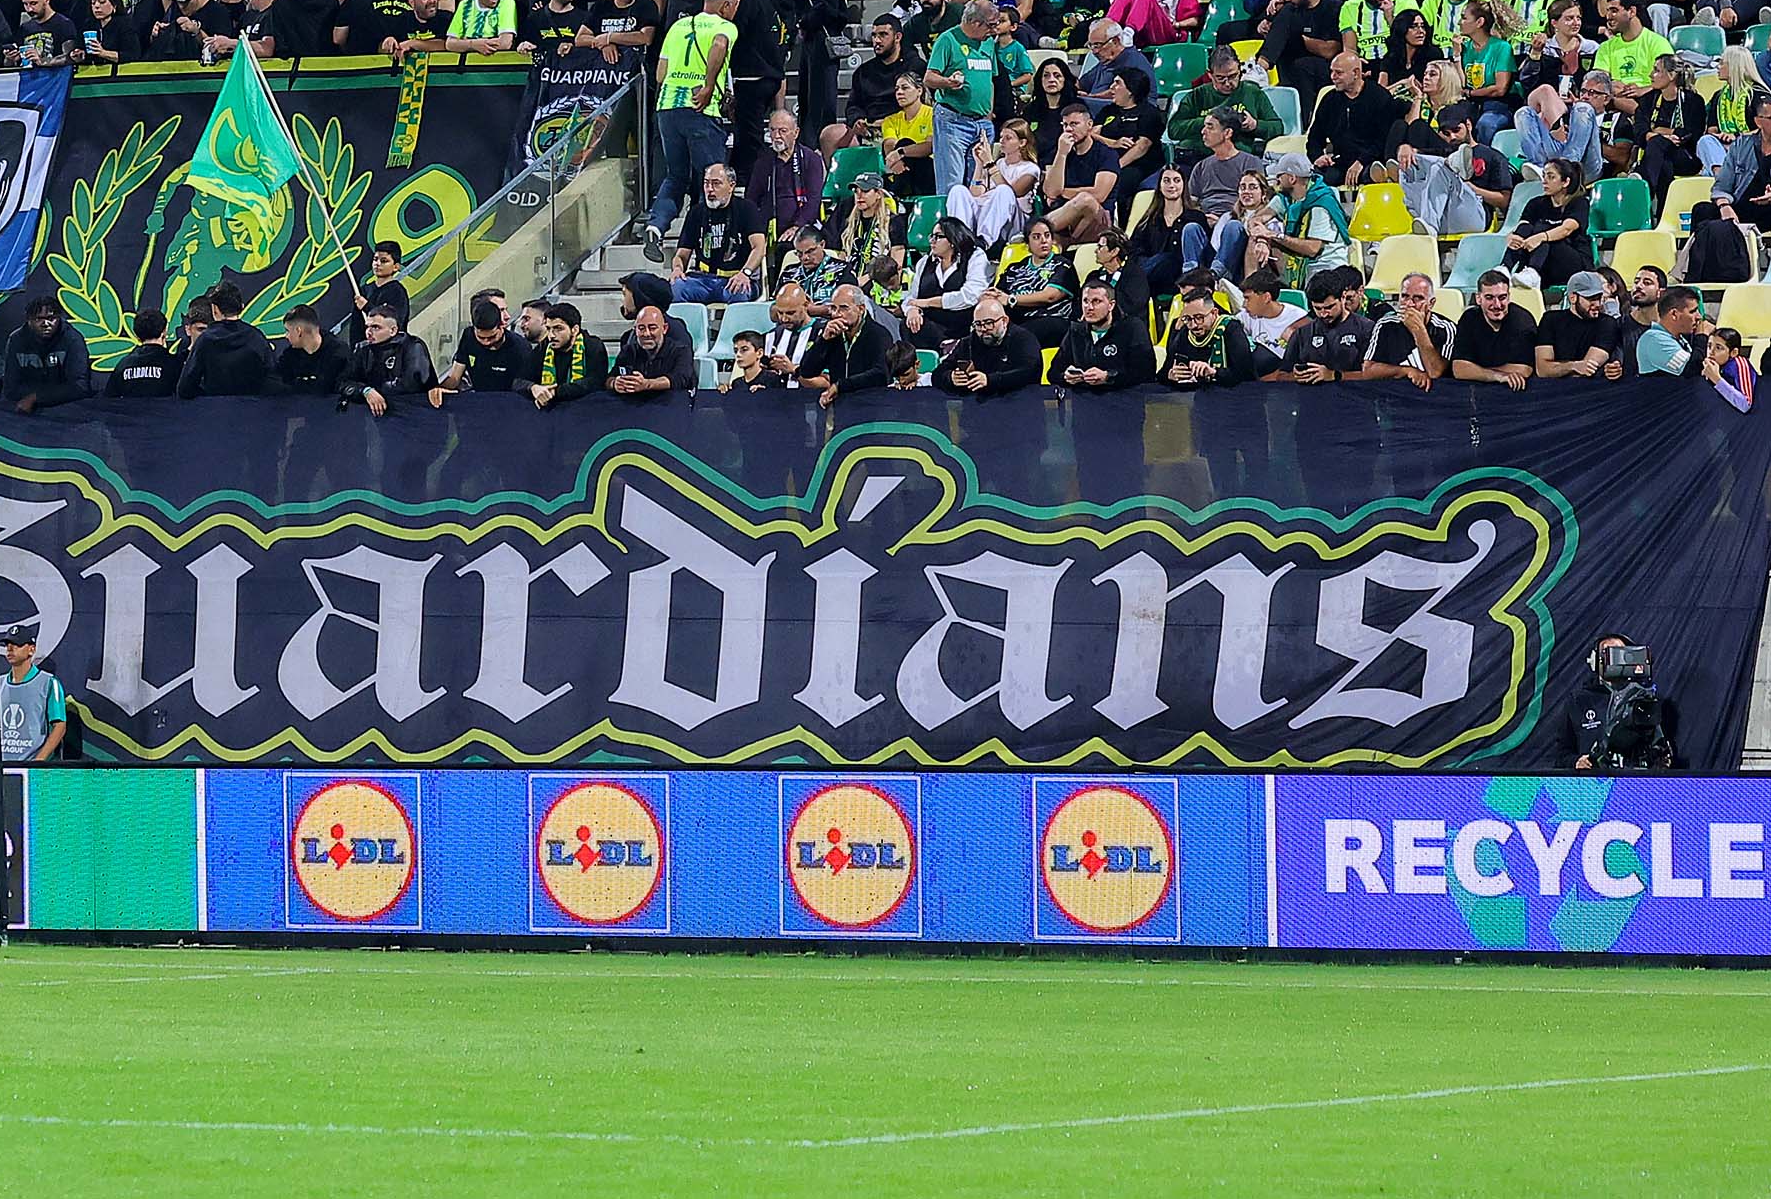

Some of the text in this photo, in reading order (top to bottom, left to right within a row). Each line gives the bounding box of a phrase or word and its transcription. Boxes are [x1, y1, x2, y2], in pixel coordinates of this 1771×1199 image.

[684, 32, 696, 67] 1
[540, 67, 632, 86] GUARDIANS
[670, 70, 706, 82] etrolina
[508, 191, 540, 207] OLD
[123, 367, 162, 381] GUARDIANS
[1, 738, 34, 748] FERENCE
[1, 746, 26, 754] EAGUE
[1324, 818, 1766, 900] RECYCLE
